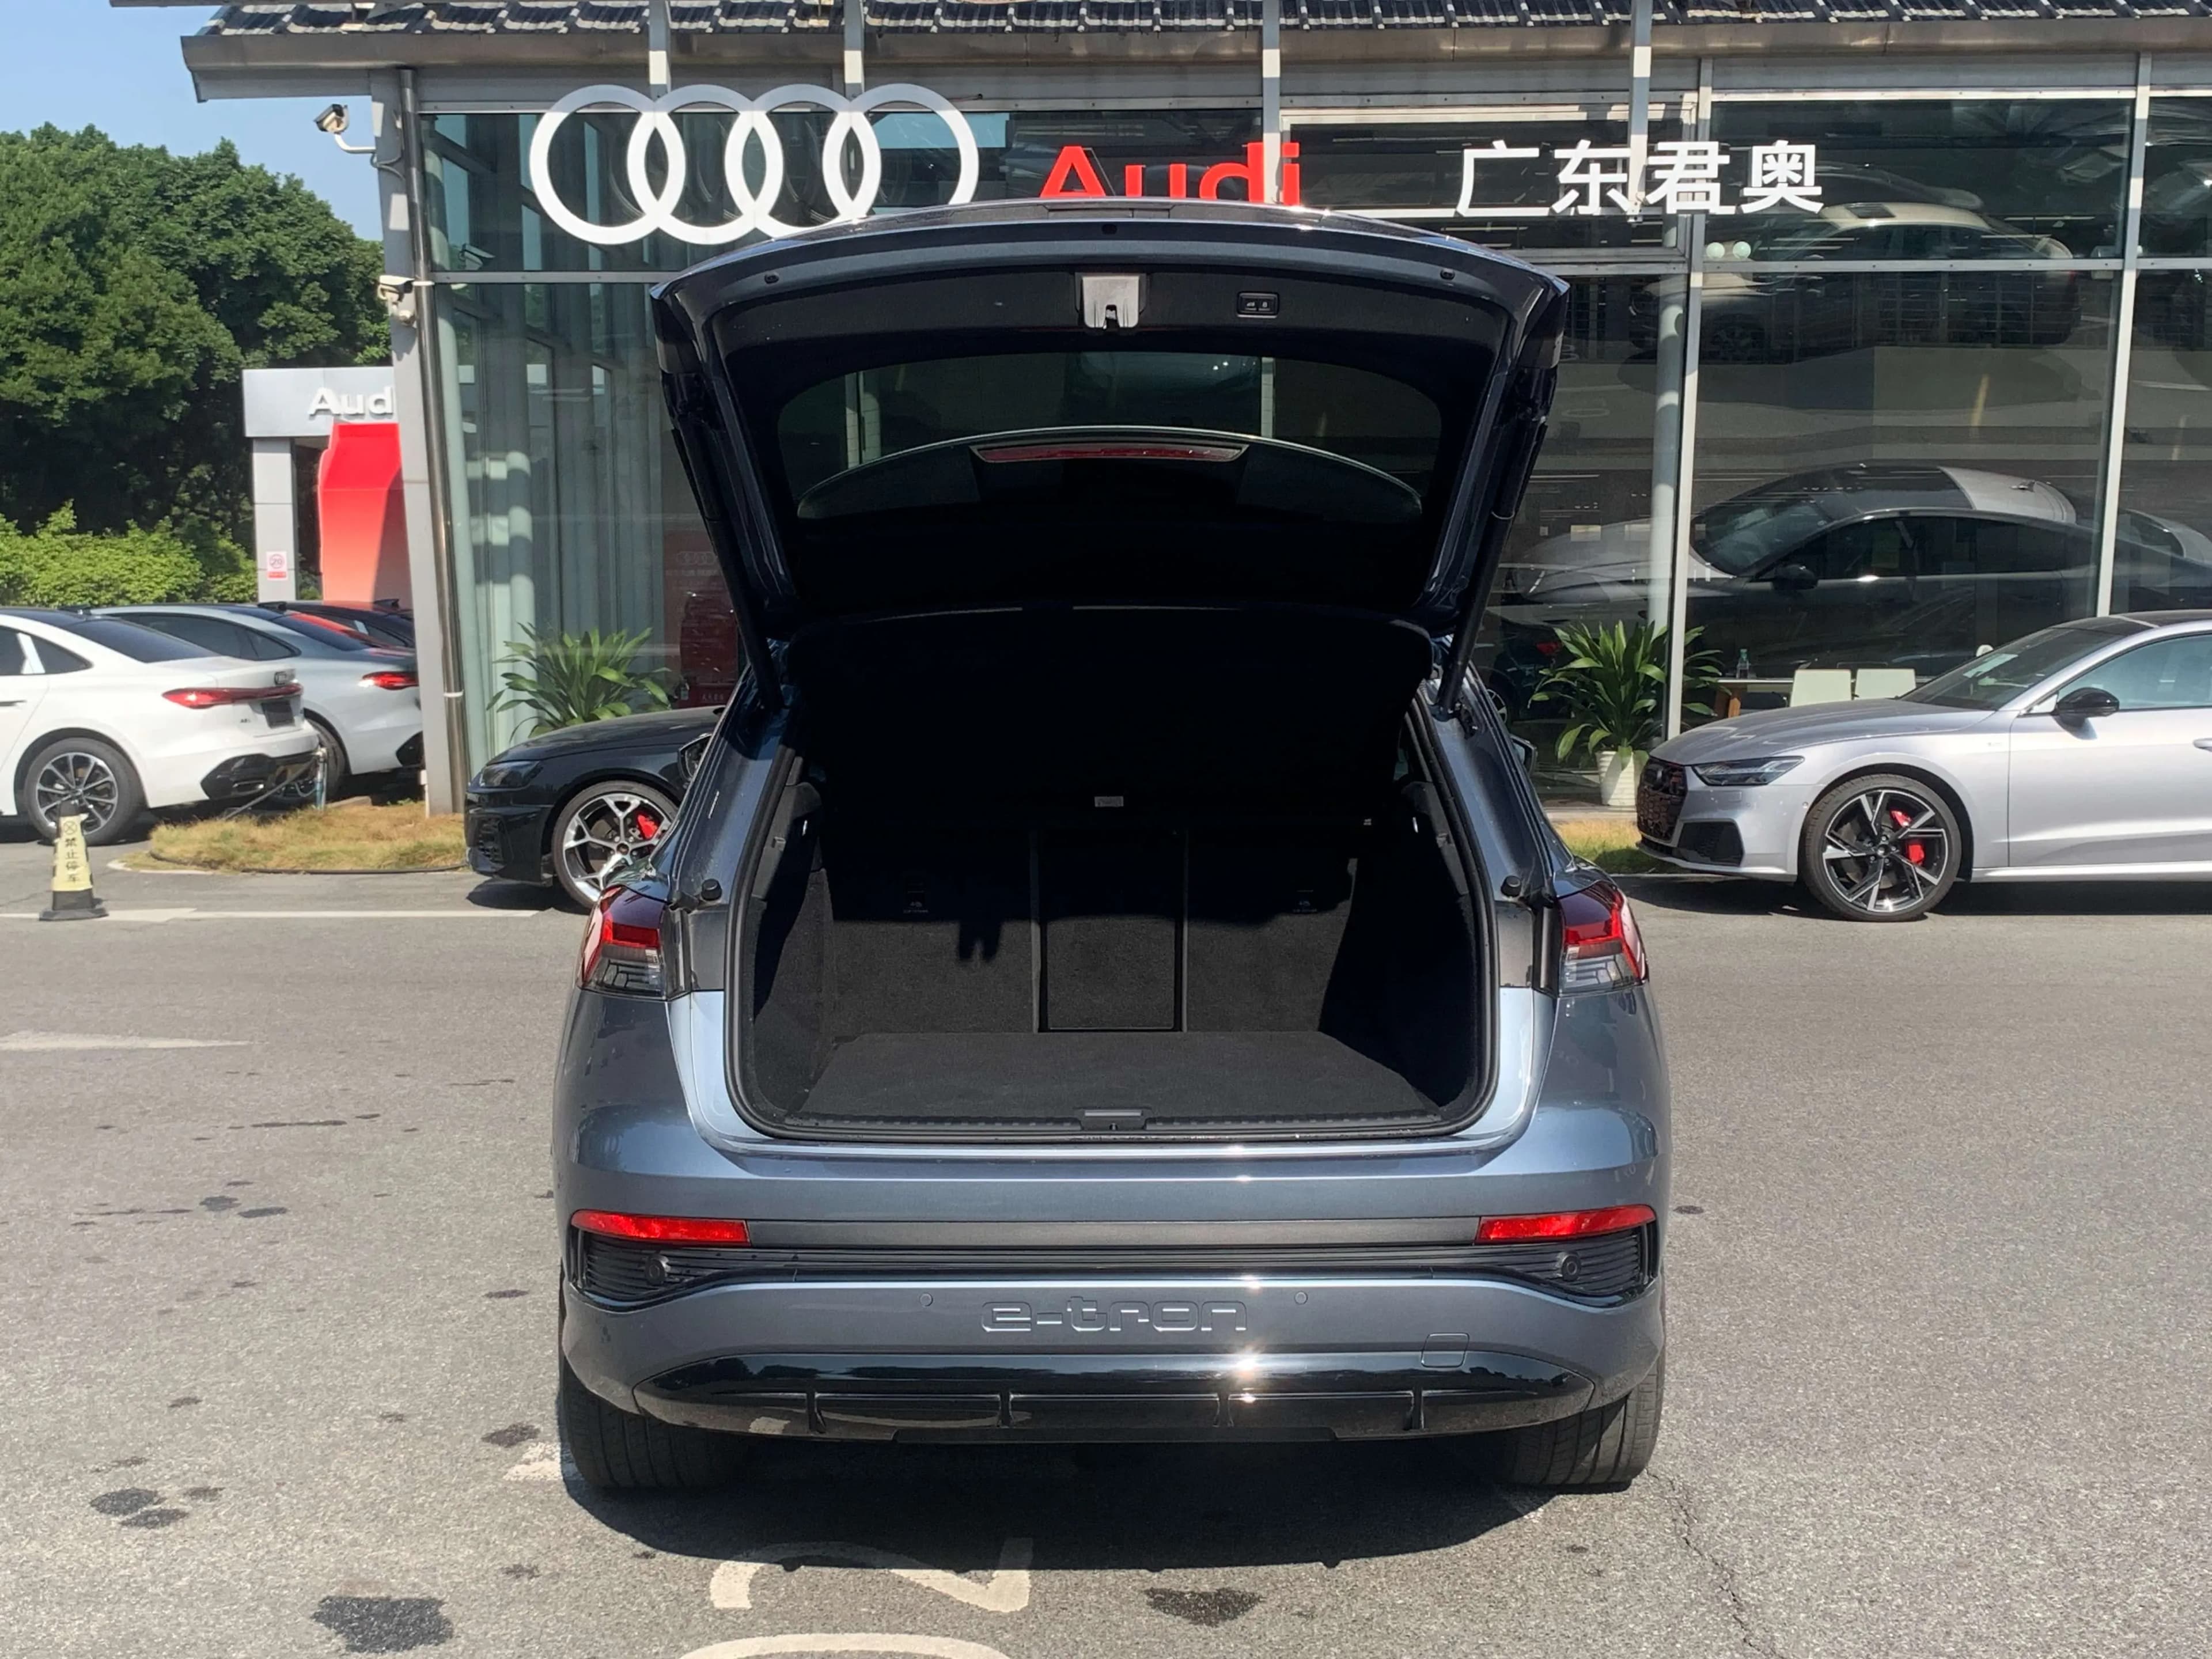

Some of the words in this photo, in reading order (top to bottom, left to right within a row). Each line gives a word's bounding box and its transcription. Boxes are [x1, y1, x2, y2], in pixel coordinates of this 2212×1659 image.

[1039, 142, 1300, 205] Audi
[1456, 139, 1824, 216] 广东君奥
[308, 386, 393, 417] Aud
[982, 1296, 1247, 1332] e-tron
